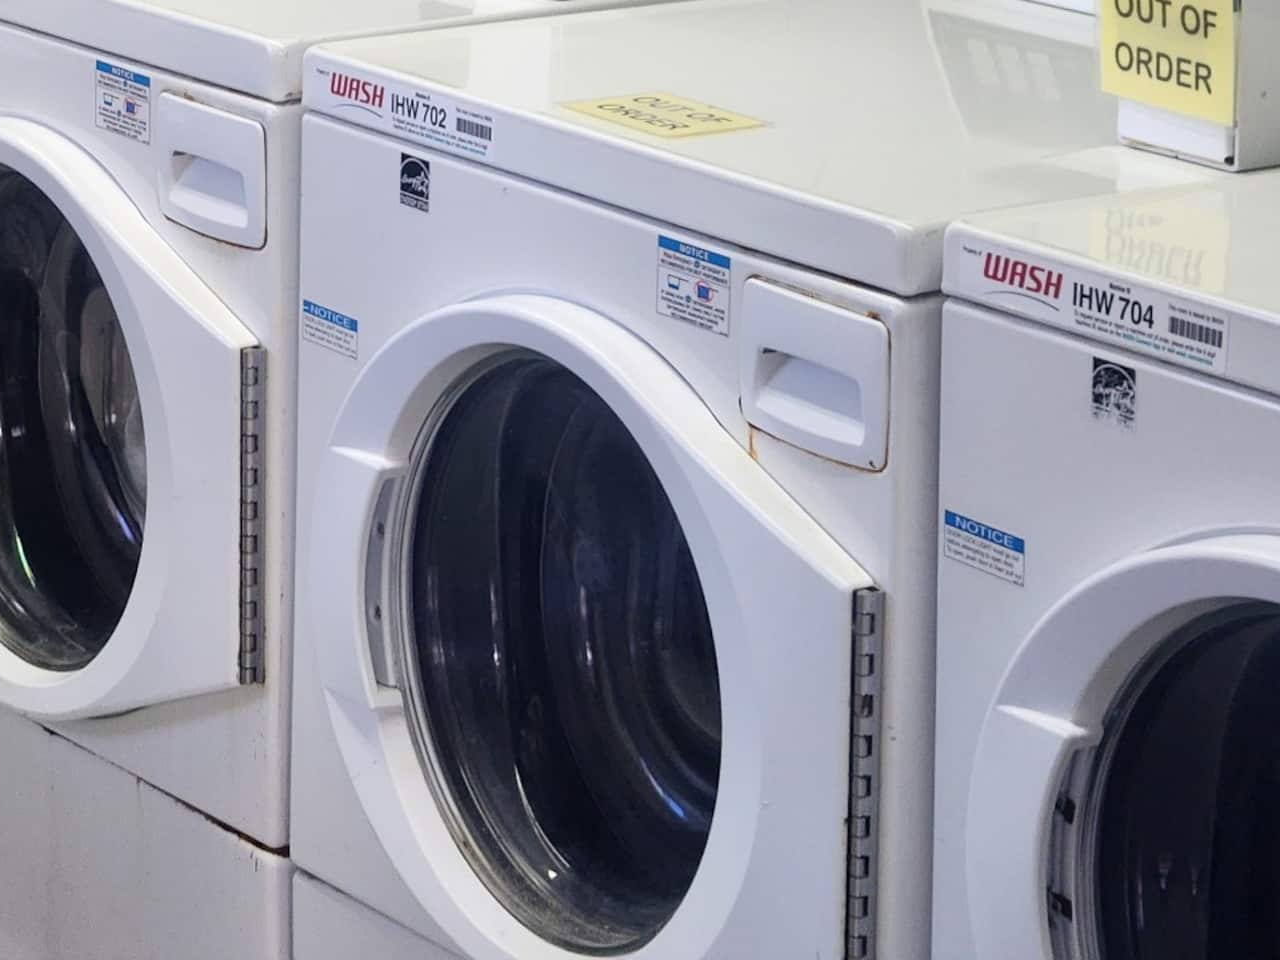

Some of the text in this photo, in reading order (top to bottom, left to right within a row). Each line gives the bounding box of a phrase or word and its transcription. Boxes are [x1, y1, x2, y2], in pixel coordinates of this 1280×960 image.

[1180, 4, 1217, 39] OF
[1114, 41, 1212, 95] ORDER
[330, 71, 385, 108] WASH
[391, 93, 420, 120] IHW
[422, 103, 447, 129] 702
[597, 103, 691, 131] ORDER
[632, 96, 733, 124] OUT OF
[679, 243, 708, 261] NOTICE
[983, 251, 1063, 299] WASH
[310, 303, 351, 329] NOTICE
[1072, 281, 1115, 316] IHW
[1118, 295, 1155, 329] 704
[955, 515, 1013, 548] NOTICE
